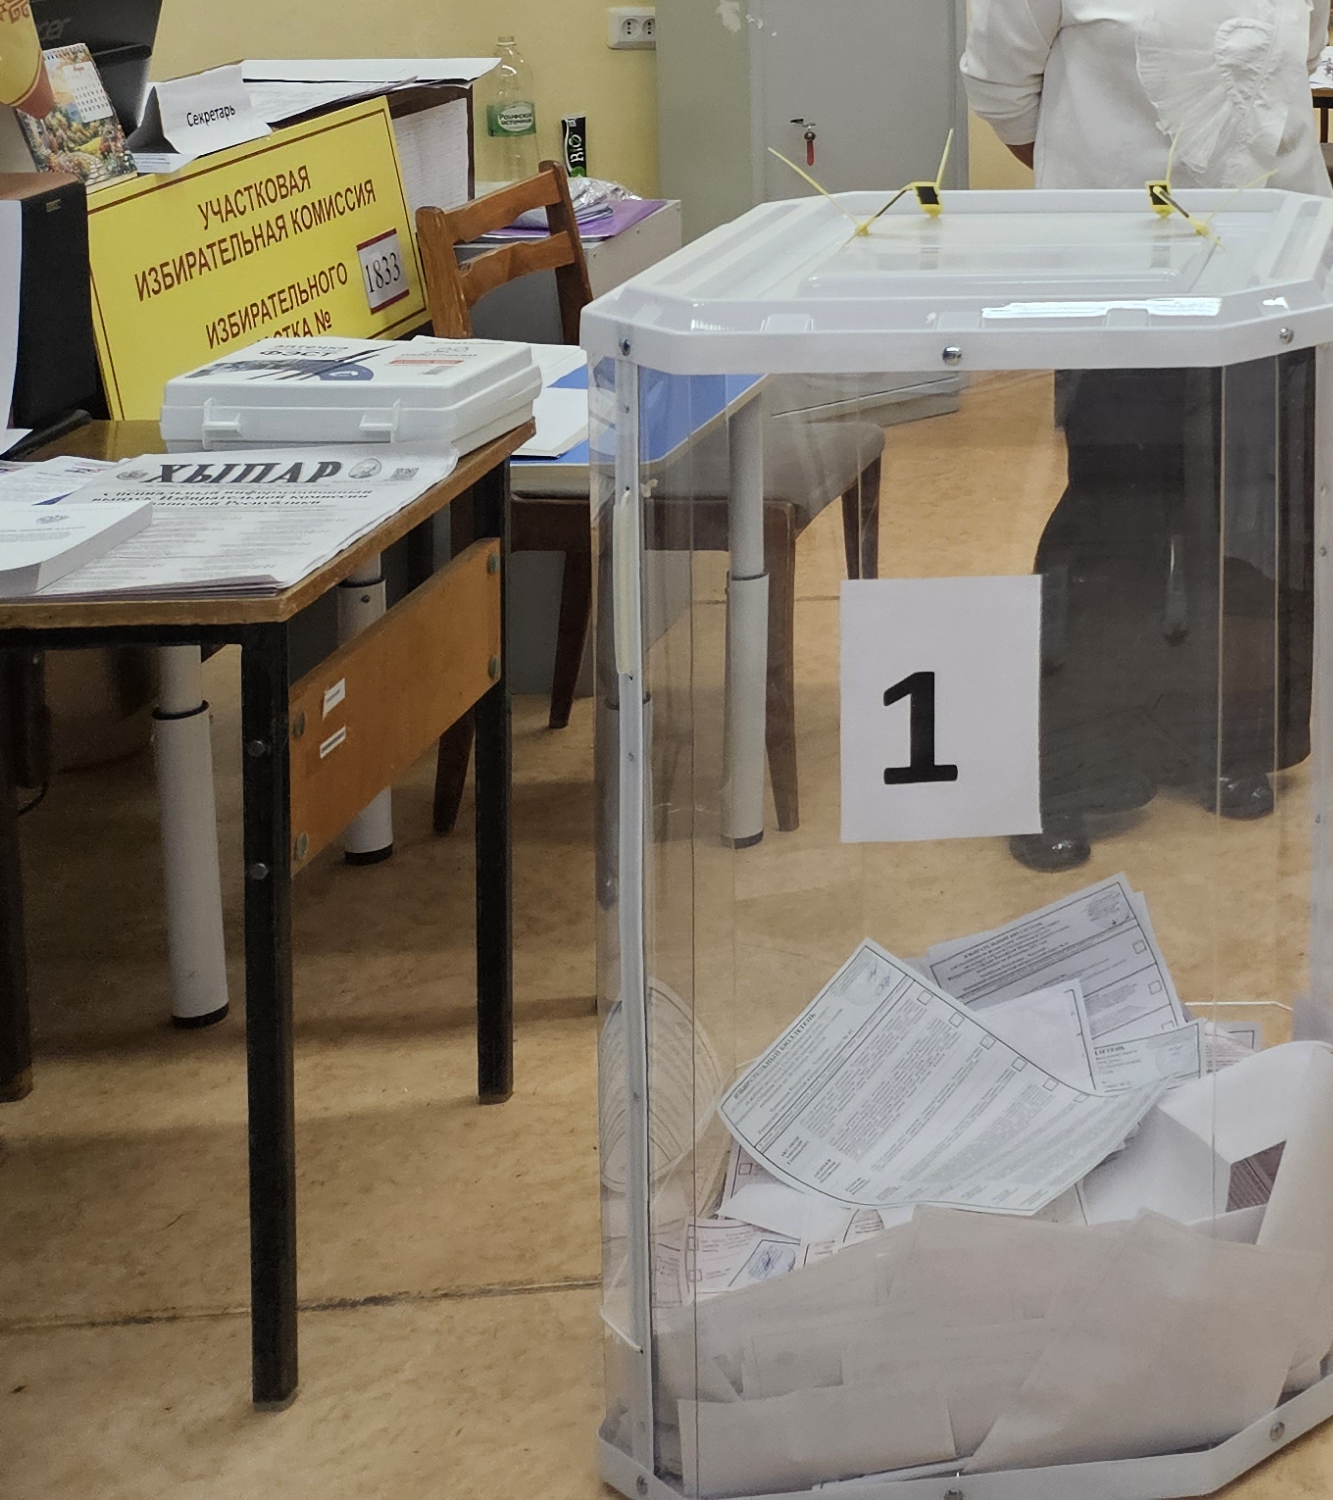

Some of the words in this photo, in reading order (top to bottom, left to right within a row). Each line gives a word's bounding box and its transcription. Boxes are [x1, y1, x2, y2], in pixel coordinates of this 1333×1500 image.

[38, 18, 71, 41] cer
[186, 104, 236, 128] Секретарь
[197, 165, 311, 230] УЧАСТКОВАЯ
[134, 214, 289, 302] ИЗБИРАТЕЛЬНАЯ
[291, 179, 376, 235] КОМИССИЯ
[364, 252, 401, 294] 1833
[205, 262, 348, 349] ИЗБИРАТЕЛЬНОГО
[314, 309, 332, 334] №
[144, 461, 343, 483] ХЫПАР
[882, 670, 958, 785] 1
